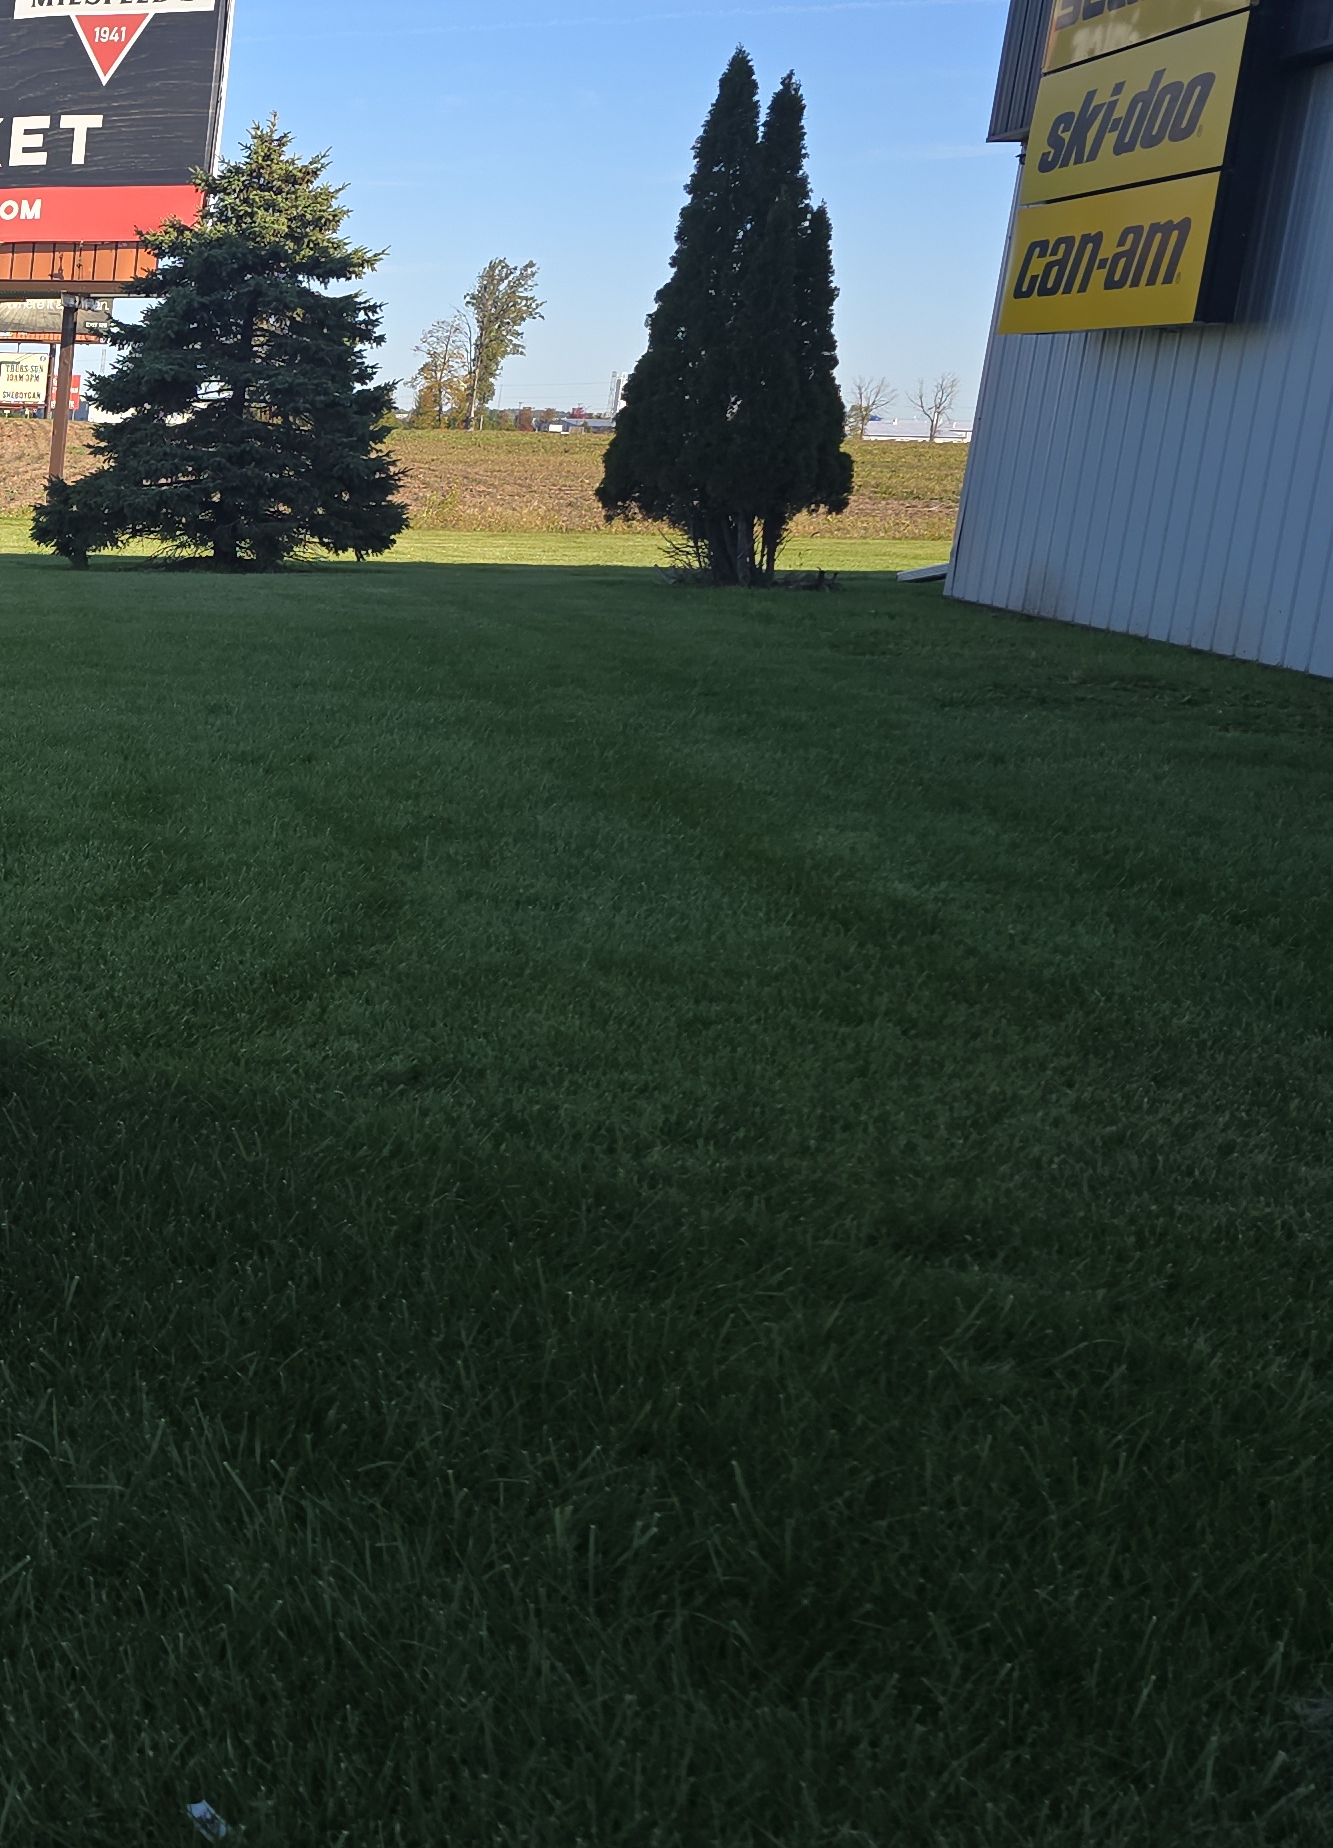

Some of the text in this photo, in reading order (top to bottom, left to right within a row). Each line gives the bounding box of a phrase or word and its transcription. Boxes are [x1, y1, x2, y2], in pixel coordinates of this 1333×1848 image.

[94, 26, 126, 42] 1941
[1037, 68, 1216, 173] ski-doo
[1013, 216, 1192, 299] can-am
